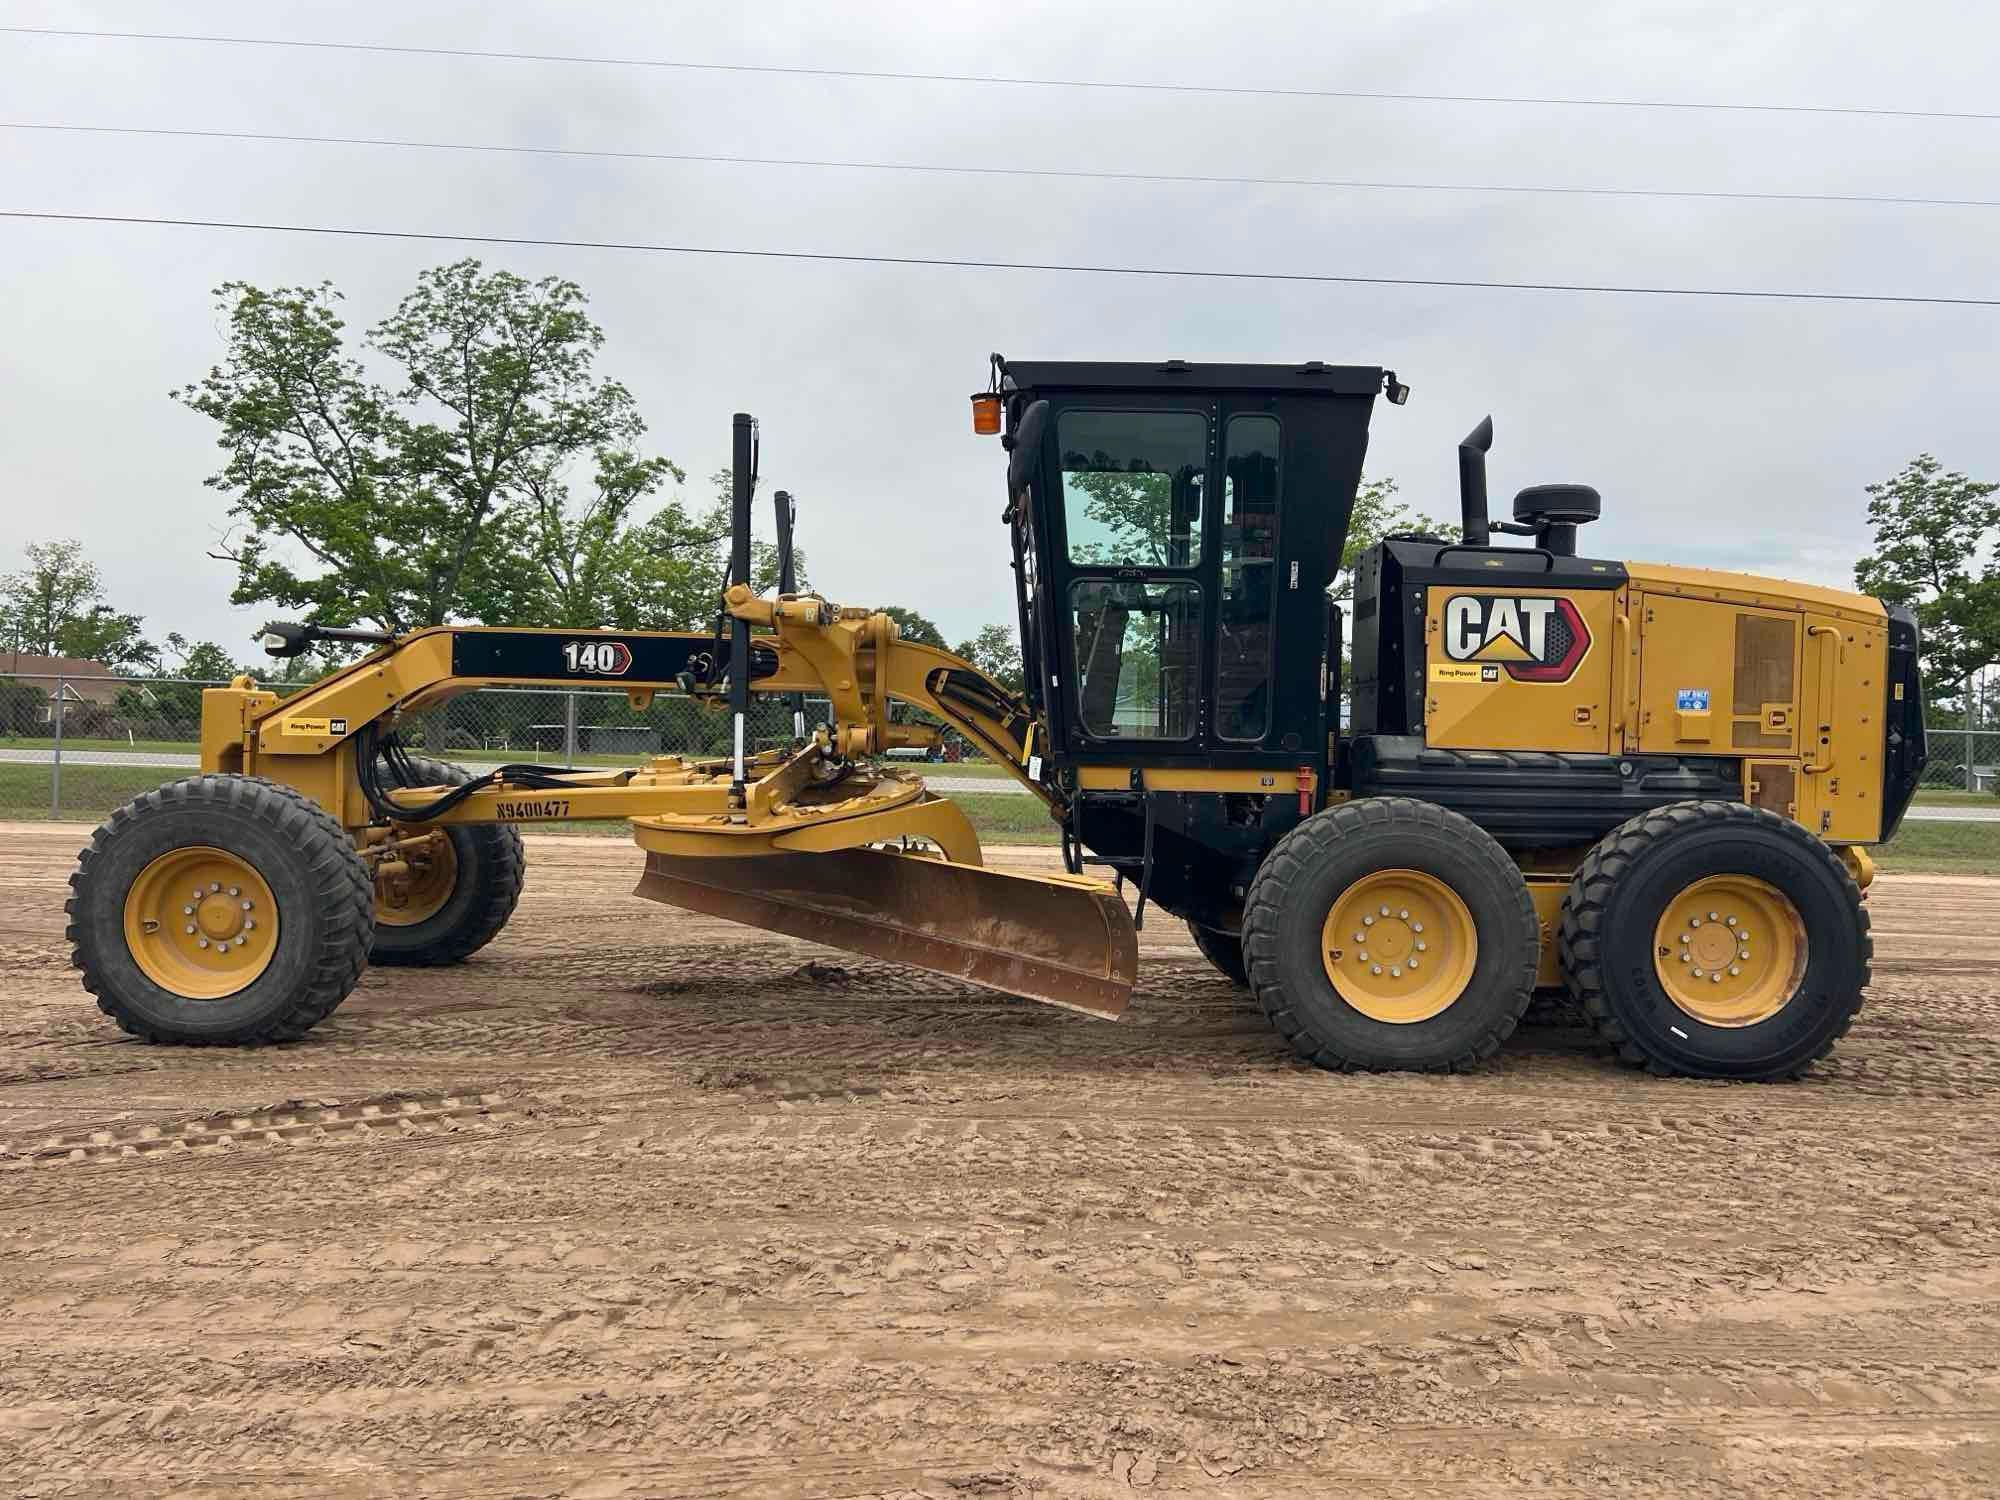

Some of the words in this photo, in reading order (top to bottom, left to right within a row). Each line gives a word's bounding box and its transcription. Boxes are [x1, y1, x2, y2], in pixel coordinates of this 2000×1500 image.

[1447, 597, 1555, 661] CAT
[565, 644, 615, 671] 140
[1482, 669, 1497, 679] CAT
[331, 722, 346, 732] CAT
[496, 801, 569, 818] N9400477
